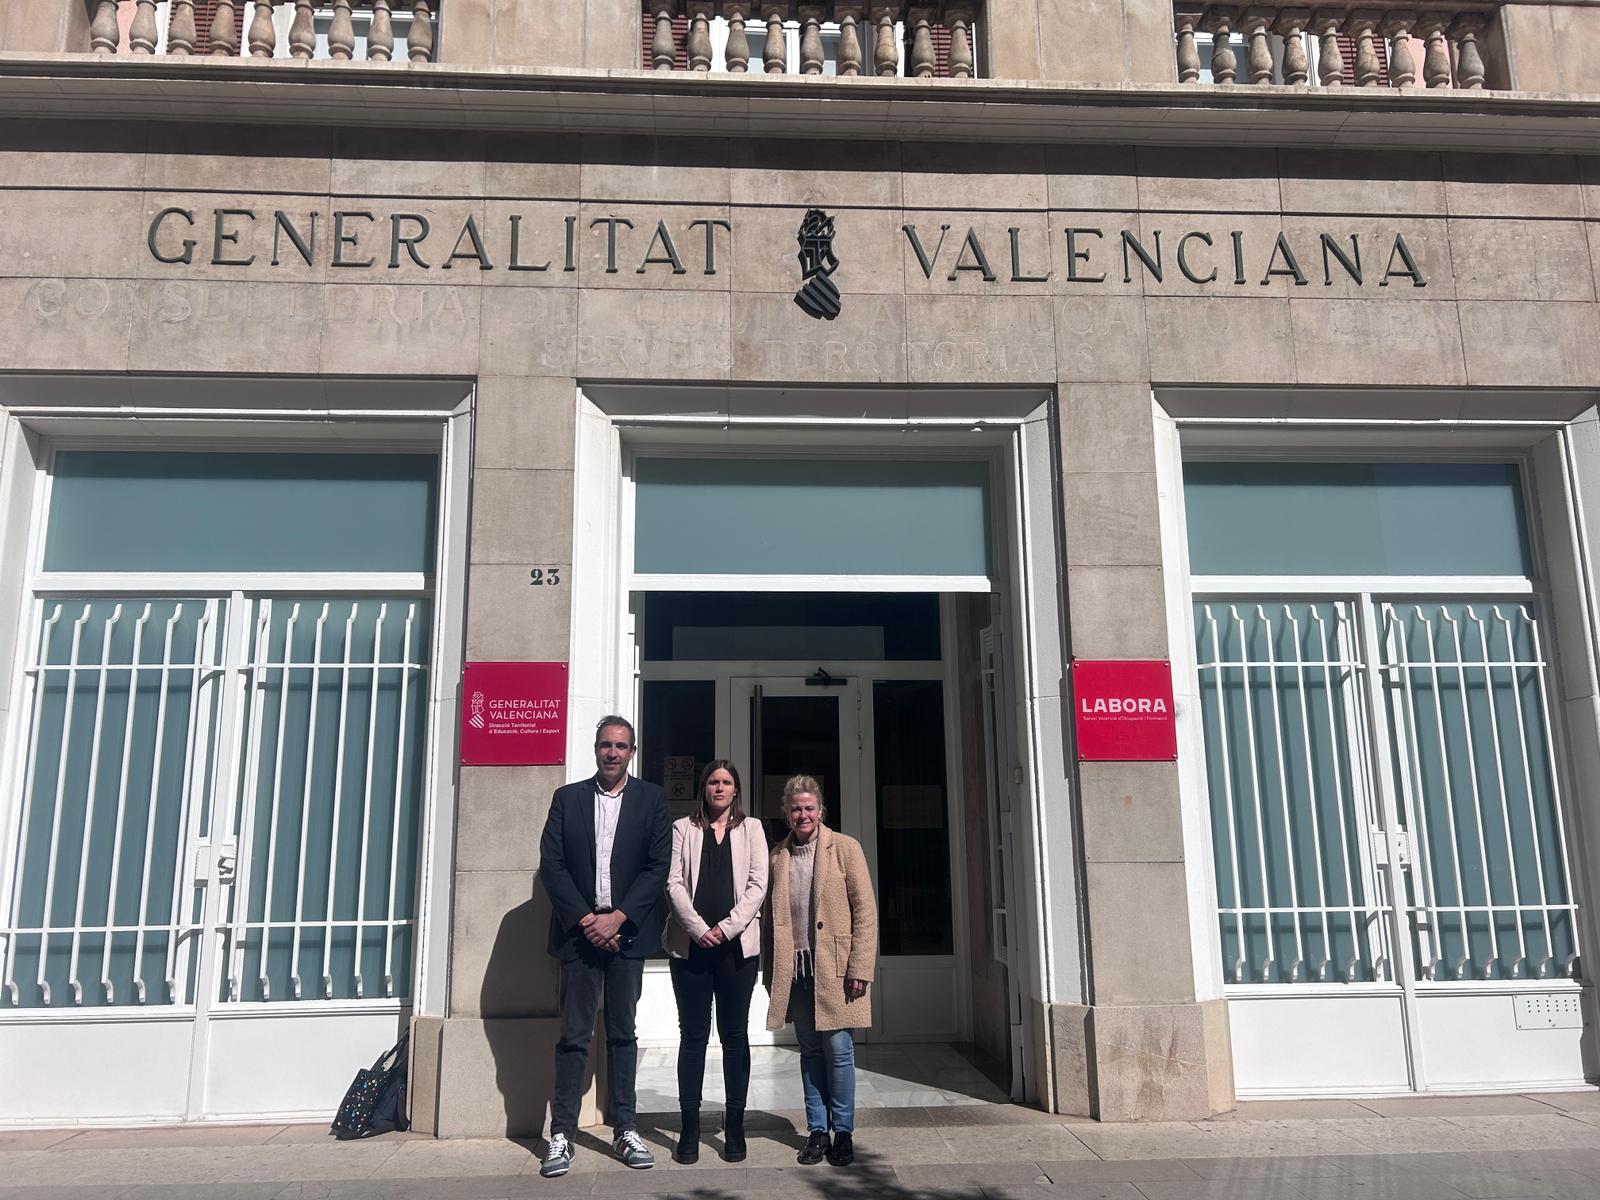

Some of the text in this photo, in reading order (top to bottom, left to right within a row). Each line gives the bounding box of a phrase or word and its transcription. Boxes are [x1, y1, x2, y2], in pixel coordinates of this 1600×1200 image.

[147, 206, 1428, 287] GENERALITAT VALENCIANA
[530, 568, 560, 586] 23
[489, 699, 560, 708] GENERALITAT
[1082, 698, 1167, 713] LABORA
[490, 710, 559, 720] VALENCIANA
